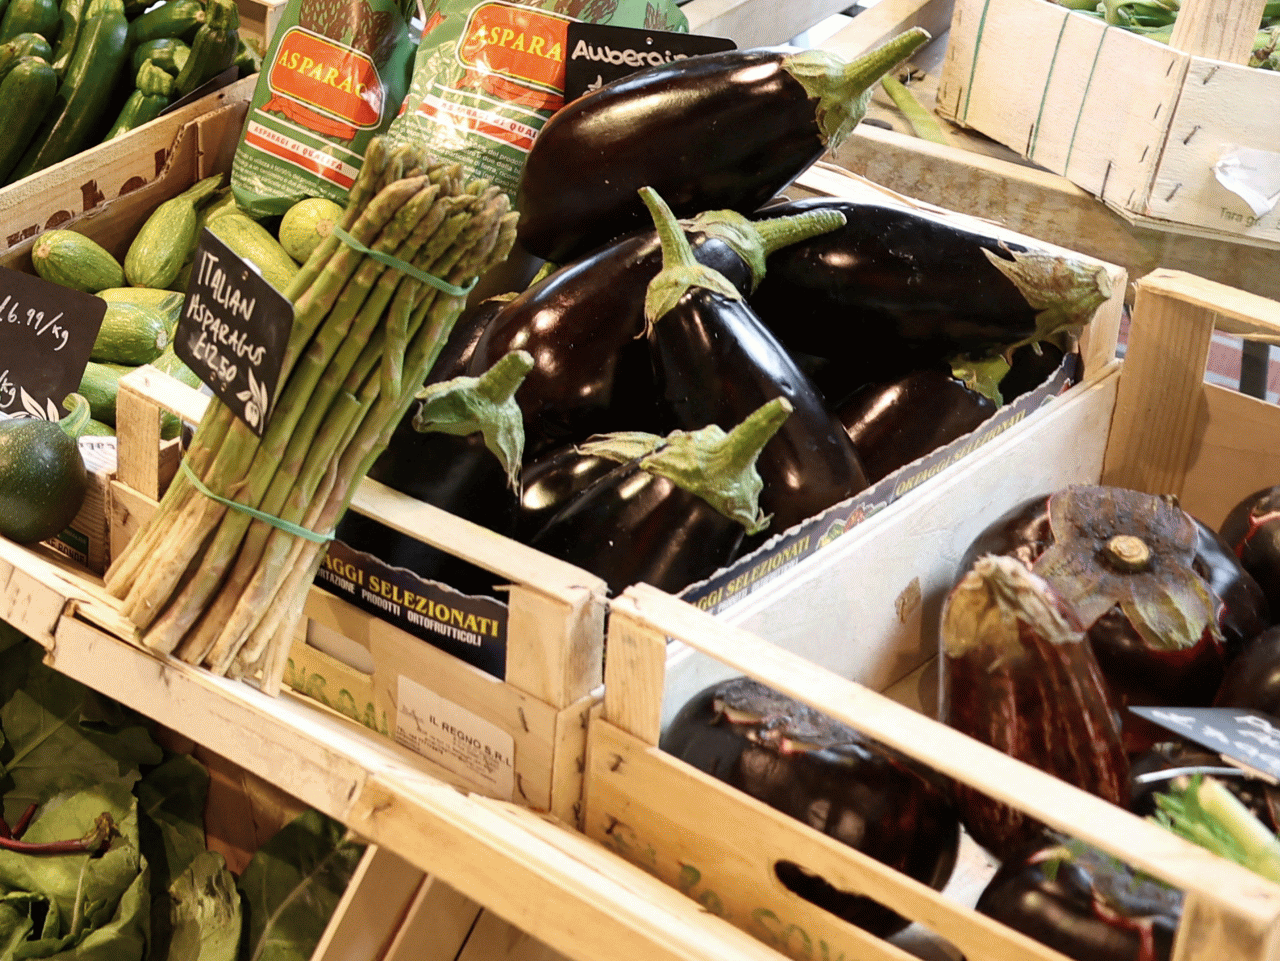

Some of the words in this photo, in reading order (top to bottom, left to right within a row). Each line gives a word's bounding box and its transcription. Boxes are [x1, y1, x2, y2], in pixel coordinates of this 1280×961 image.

[471, 24, 563, 63] ASPARA
[509, 122, 537, 139] QUAL
[197, 250, 256, 322] ITALIAN
[186, 293, 267, 367] ASPARAGUS
[726, 534, 810, 597] SELEZIONATI
[361, 588, 401, 617] PRODOTTI
[406, 609, 482, 647] ORTOFRUTTICOLI
[368, 575, 500, 637] SELEZIONATI
[429, 714, 440, 725] IL
[441, 721, 482, 751] REGNO
